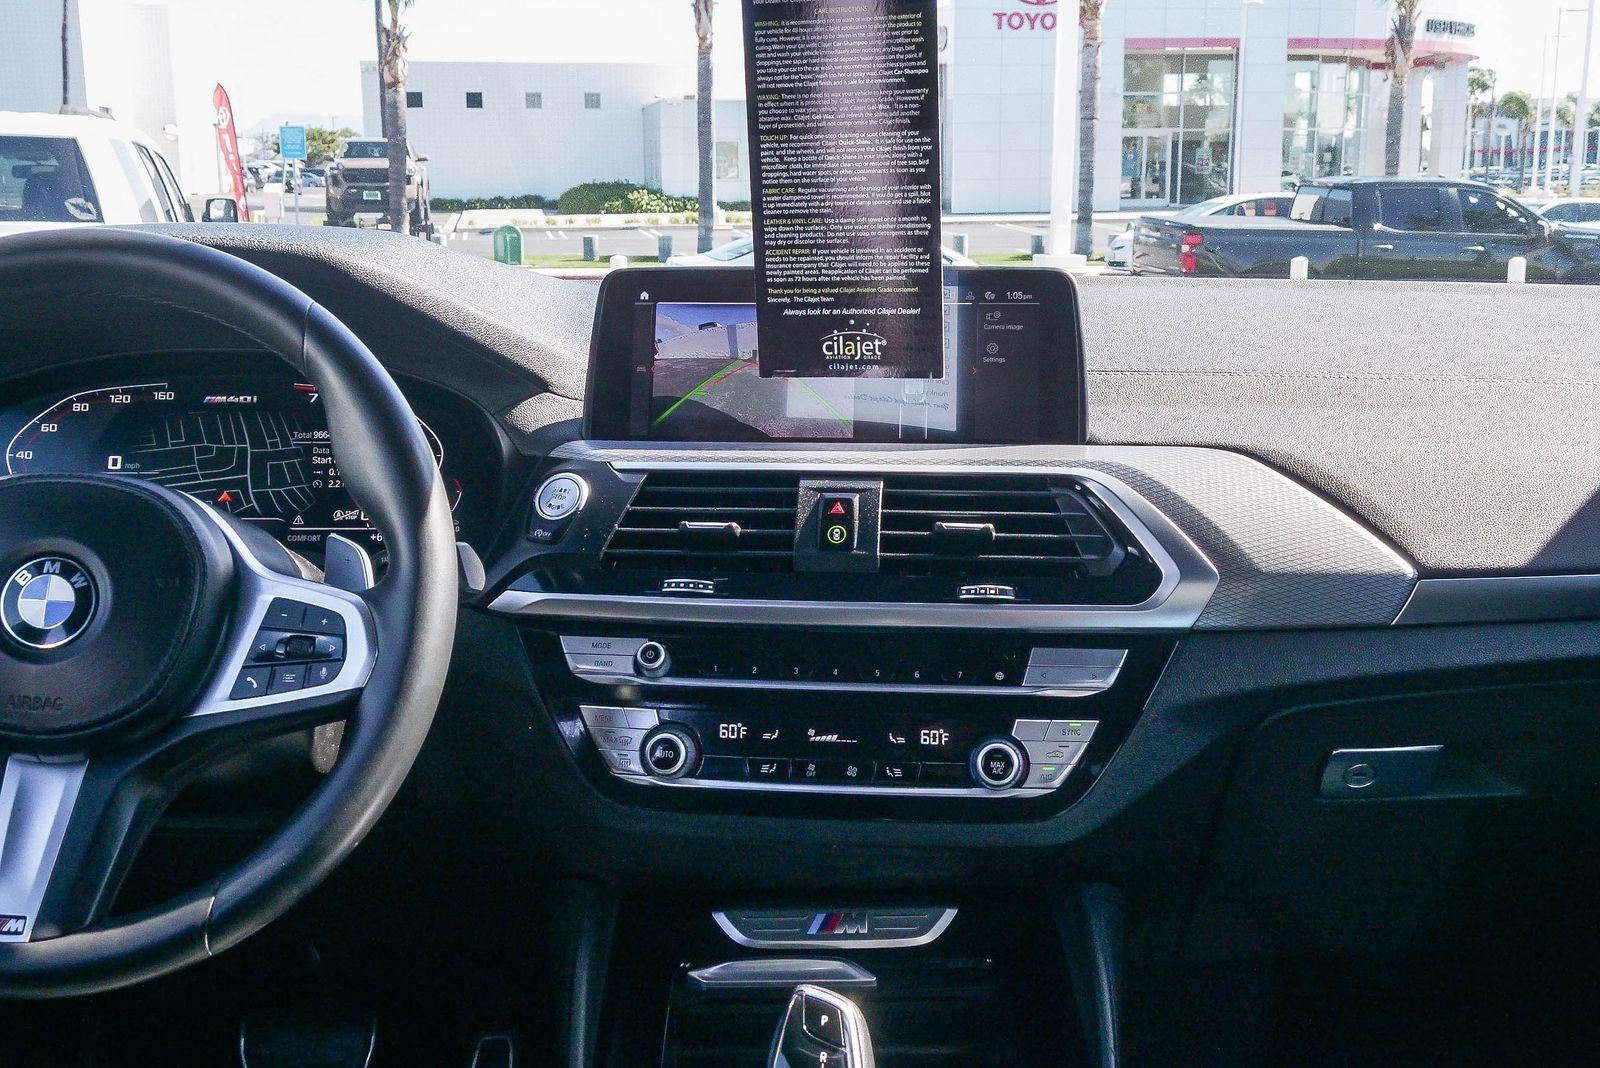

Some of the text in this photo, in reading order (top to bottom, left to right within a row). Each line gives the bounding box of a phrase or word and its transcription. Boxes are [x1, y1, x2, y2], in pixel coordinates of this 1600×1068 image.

[993, 12, 1057, 30] TOYO
[783, 308, 807, 317] Always
[876, 308, 897, 316] Cilajet
[110, 394, 130, 403] 120
[153, 392, 174, 400] 160
[308, 393, 318, 403] 7
[72, 403, 89, 412] 80
[41, 423, 58, 432] 60
[16, 450, 32, 460] 40
[312, 456, 332, 464] Start
[108, 456, 122, 469] 0
[370, 533, 383, 542] +6
[15, 560, 88, 588] BMW
[9, 695, 63, 711] AIRBAG
[2, 918, 25, 931] M
[821, 1015, 828, 1026] P
[820, 1052, 827, 1063] R
